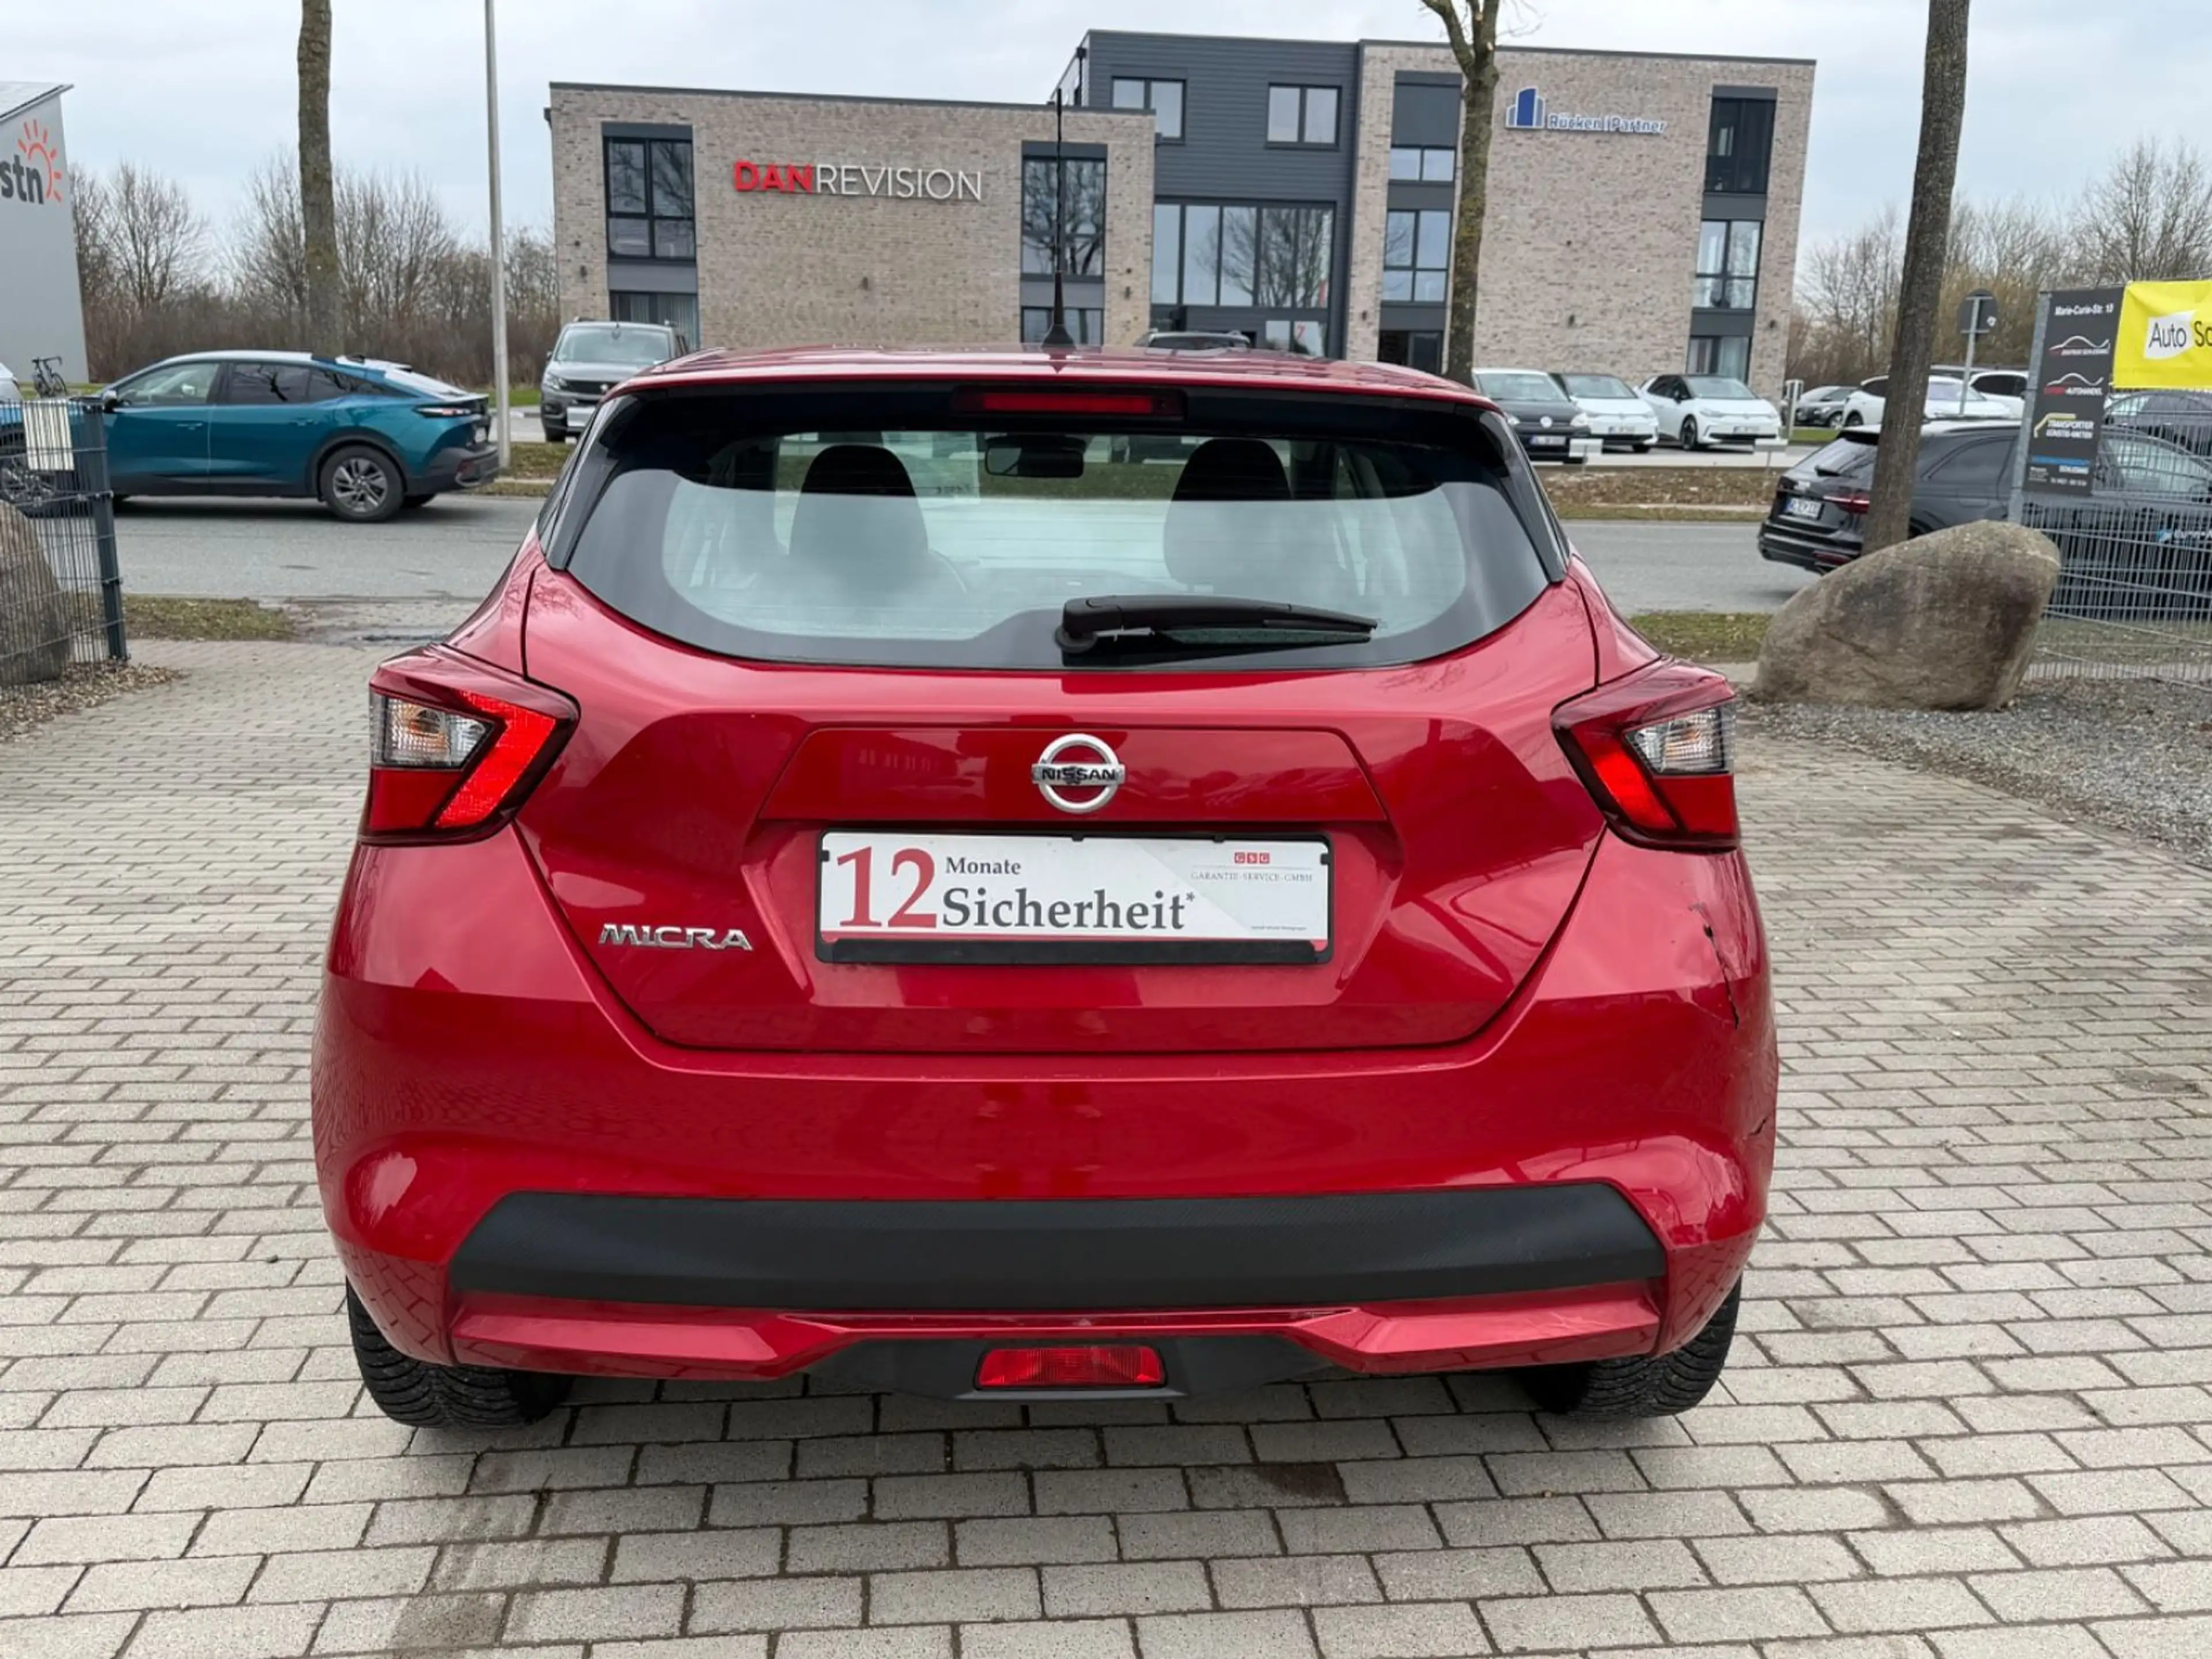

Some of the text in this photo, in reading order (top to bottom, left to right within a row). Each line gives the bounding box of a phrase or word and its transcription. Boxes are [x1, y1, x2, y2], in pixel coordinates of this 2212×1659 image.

[734, 160, 981, 200] DANREVISION
[2148, 321, 2187, 348] Auto
[1042, 767, 1115, 781] NISSAN
[837, 846, 1021, 929] 12 Monate
[599, 923, 753, 951] MICRA
